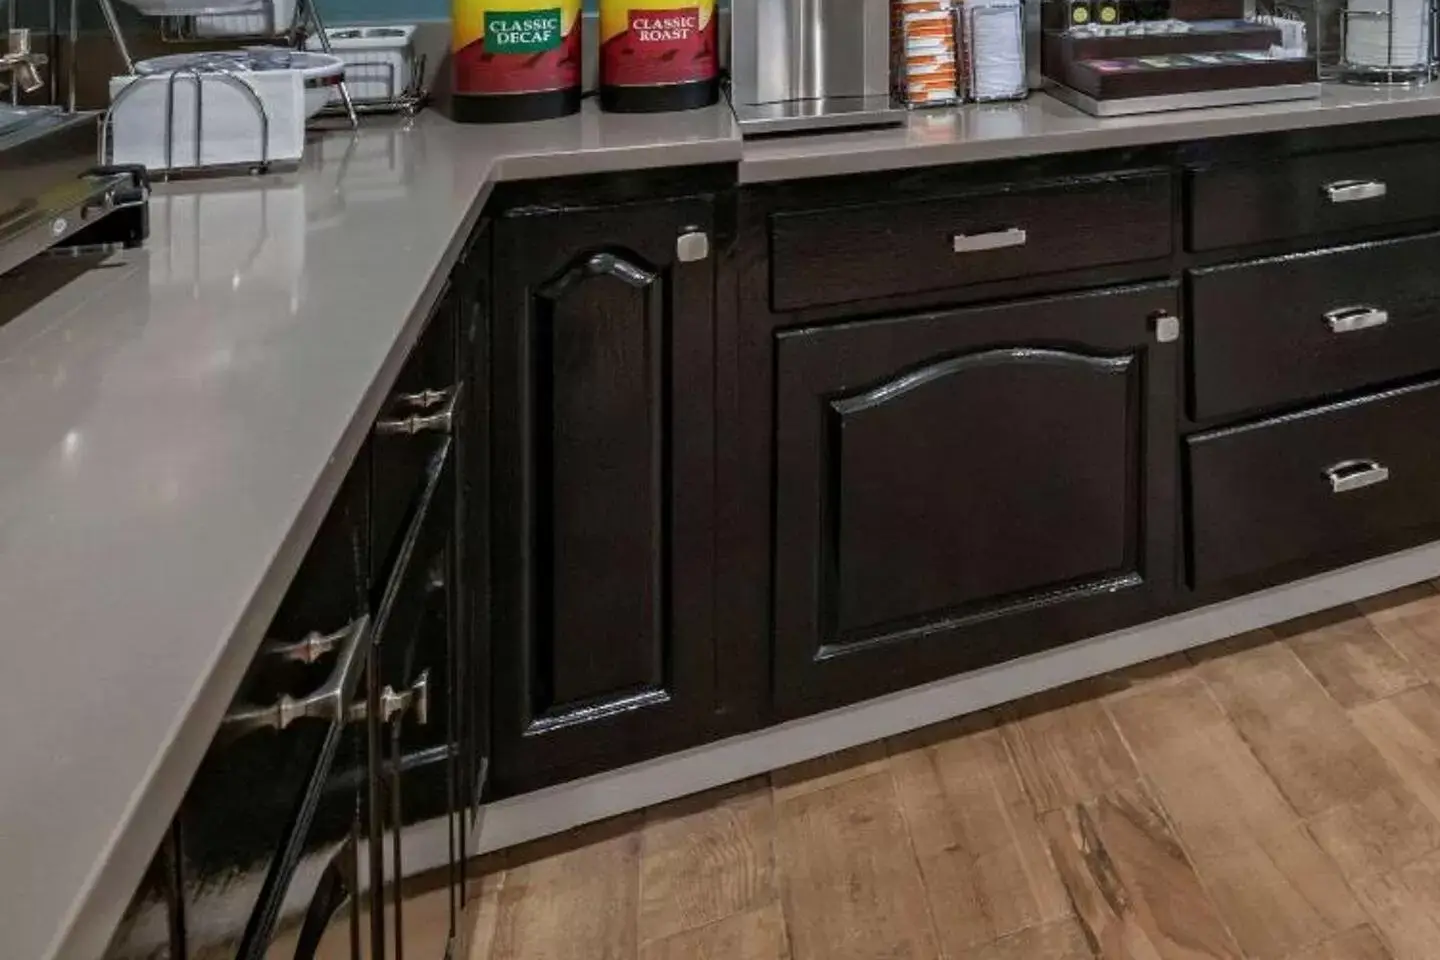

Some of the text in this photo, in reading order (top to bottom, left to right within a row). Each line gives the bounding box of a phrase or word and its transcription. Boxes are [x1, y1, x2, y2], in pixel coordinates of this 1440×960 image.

[489, 17, 559, 33] CLASSIC
[632, 15, 697, 30] CLASSIC
[496, 30, 550, 45] DECAF
[639, 27, 690, 42] ROAST
